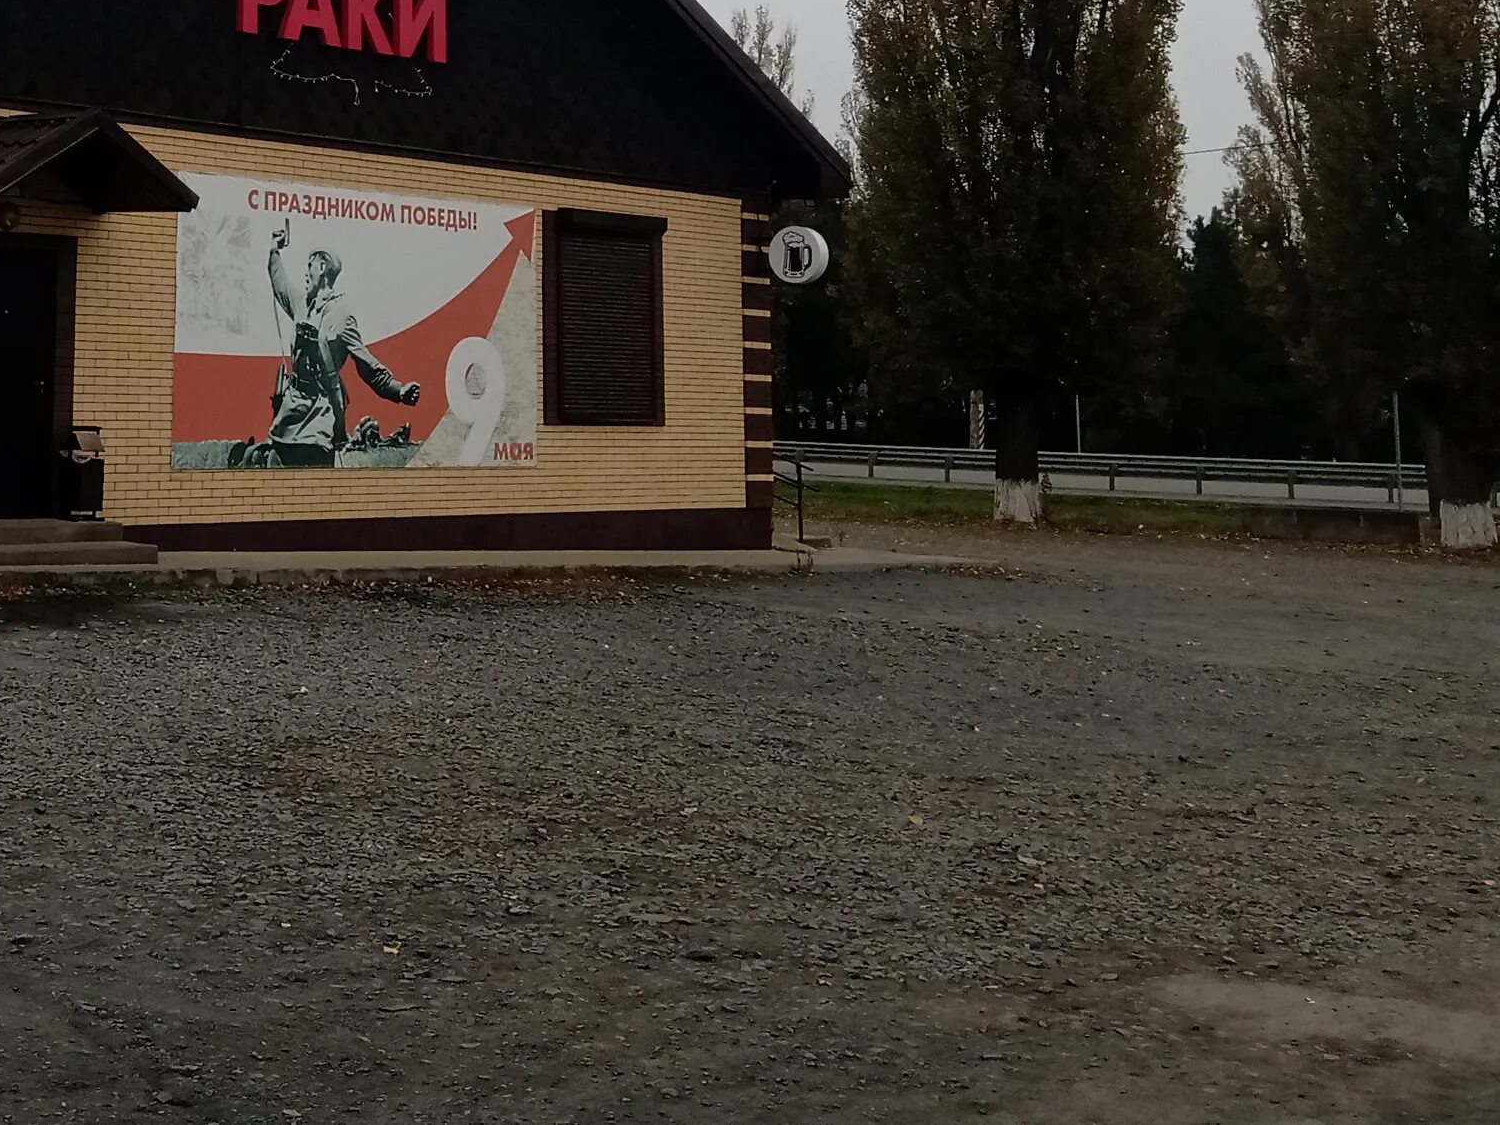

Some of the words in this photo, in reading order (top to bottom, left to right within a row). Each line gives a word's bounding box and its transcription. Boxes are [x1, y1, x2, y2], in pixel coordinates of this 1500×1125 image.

[248, 189, 259, 210] С
[264, 191, 396, 223] ПРАЗДНИКОМ
[400, 205, 477, 232] ПОБЕДЫ!
[445, 336, 505, 467] 9
